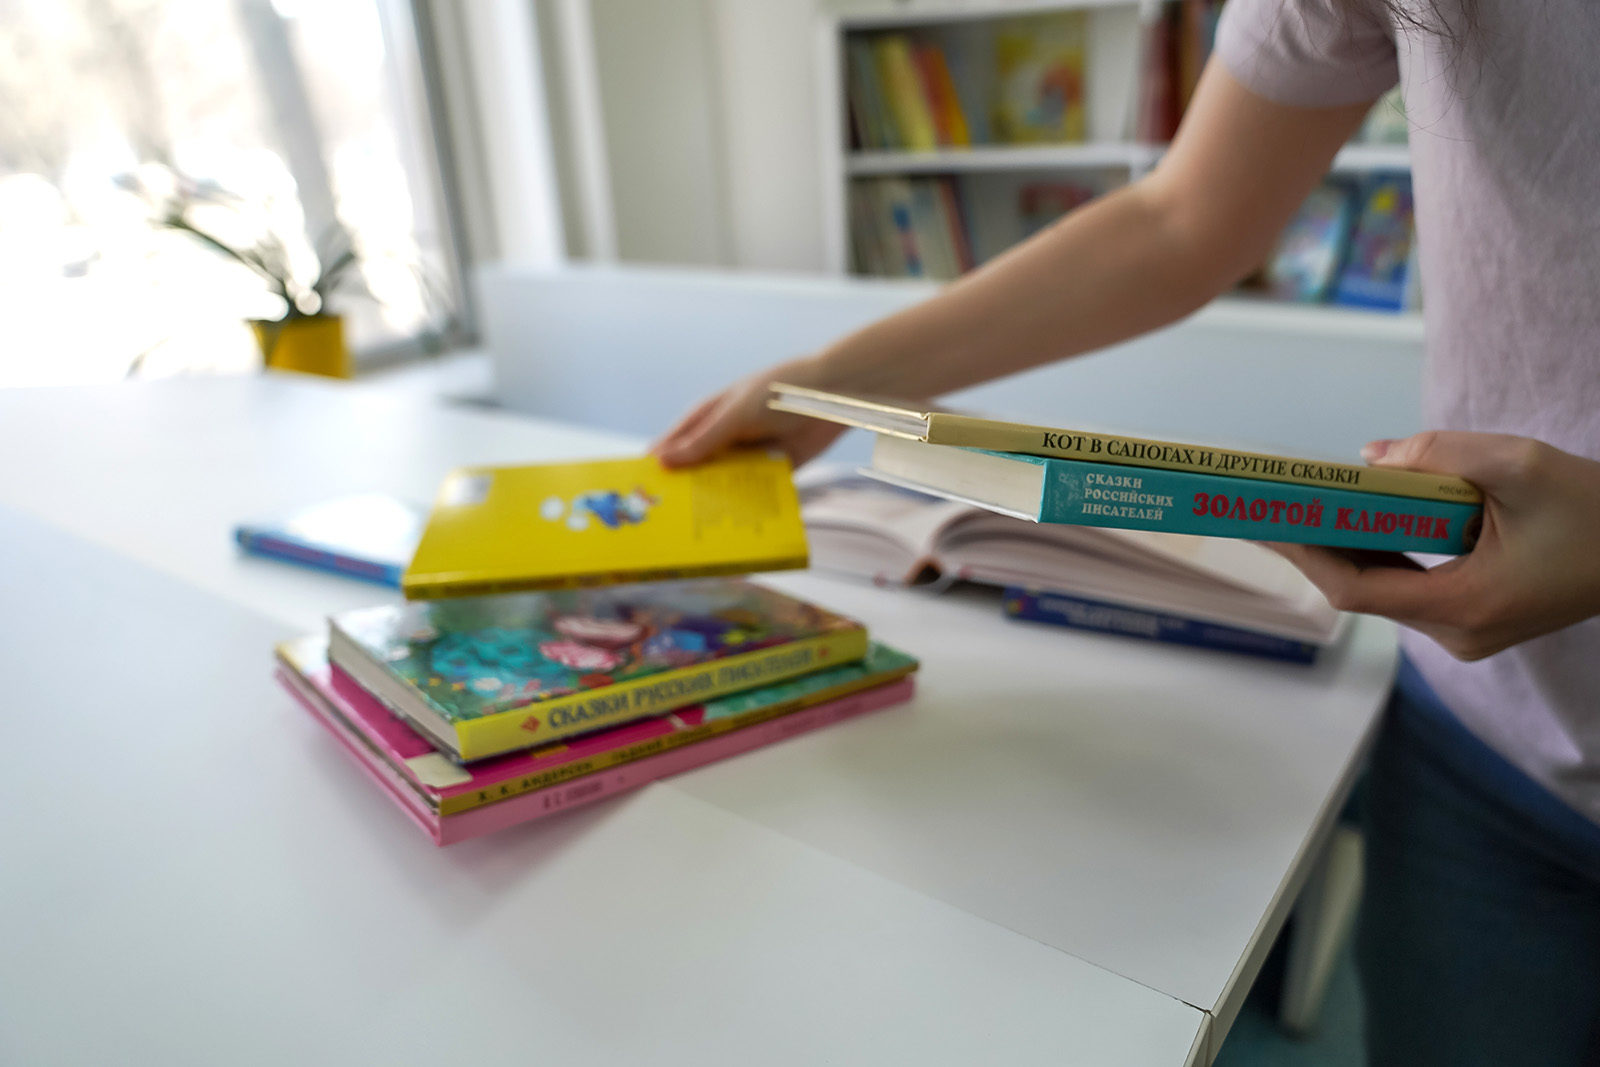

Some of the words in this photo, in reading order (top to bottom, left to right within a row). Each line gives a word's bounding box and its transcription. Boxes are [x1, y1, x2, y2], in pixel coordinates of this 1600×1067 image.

[1042, 432, 1086, 451] КОТ
[1090, 439, 1102, 453] В
[1107, 440, 1194, 465] САПОГАХ
[1199, 451, 1213, 467] И
[1215, 453, 1287, 476] ДРУГИЕ
[1291, 463, 1361, 485] СКАЗКИ
[1086, 473, 1143, 489] СКАЗКИ
[1082, 503, 1164, 521] ПИСАТЕЛЕЙ
[1084, 488, 1174, 508] РОССИЙСКИХ
[1192, 492, 1324, 528] ЗОЛОТОЙ
[1334, 507, 1450, 540] КЛЮЧИК
[548, 692, 629, 729] СКАЗКИ
